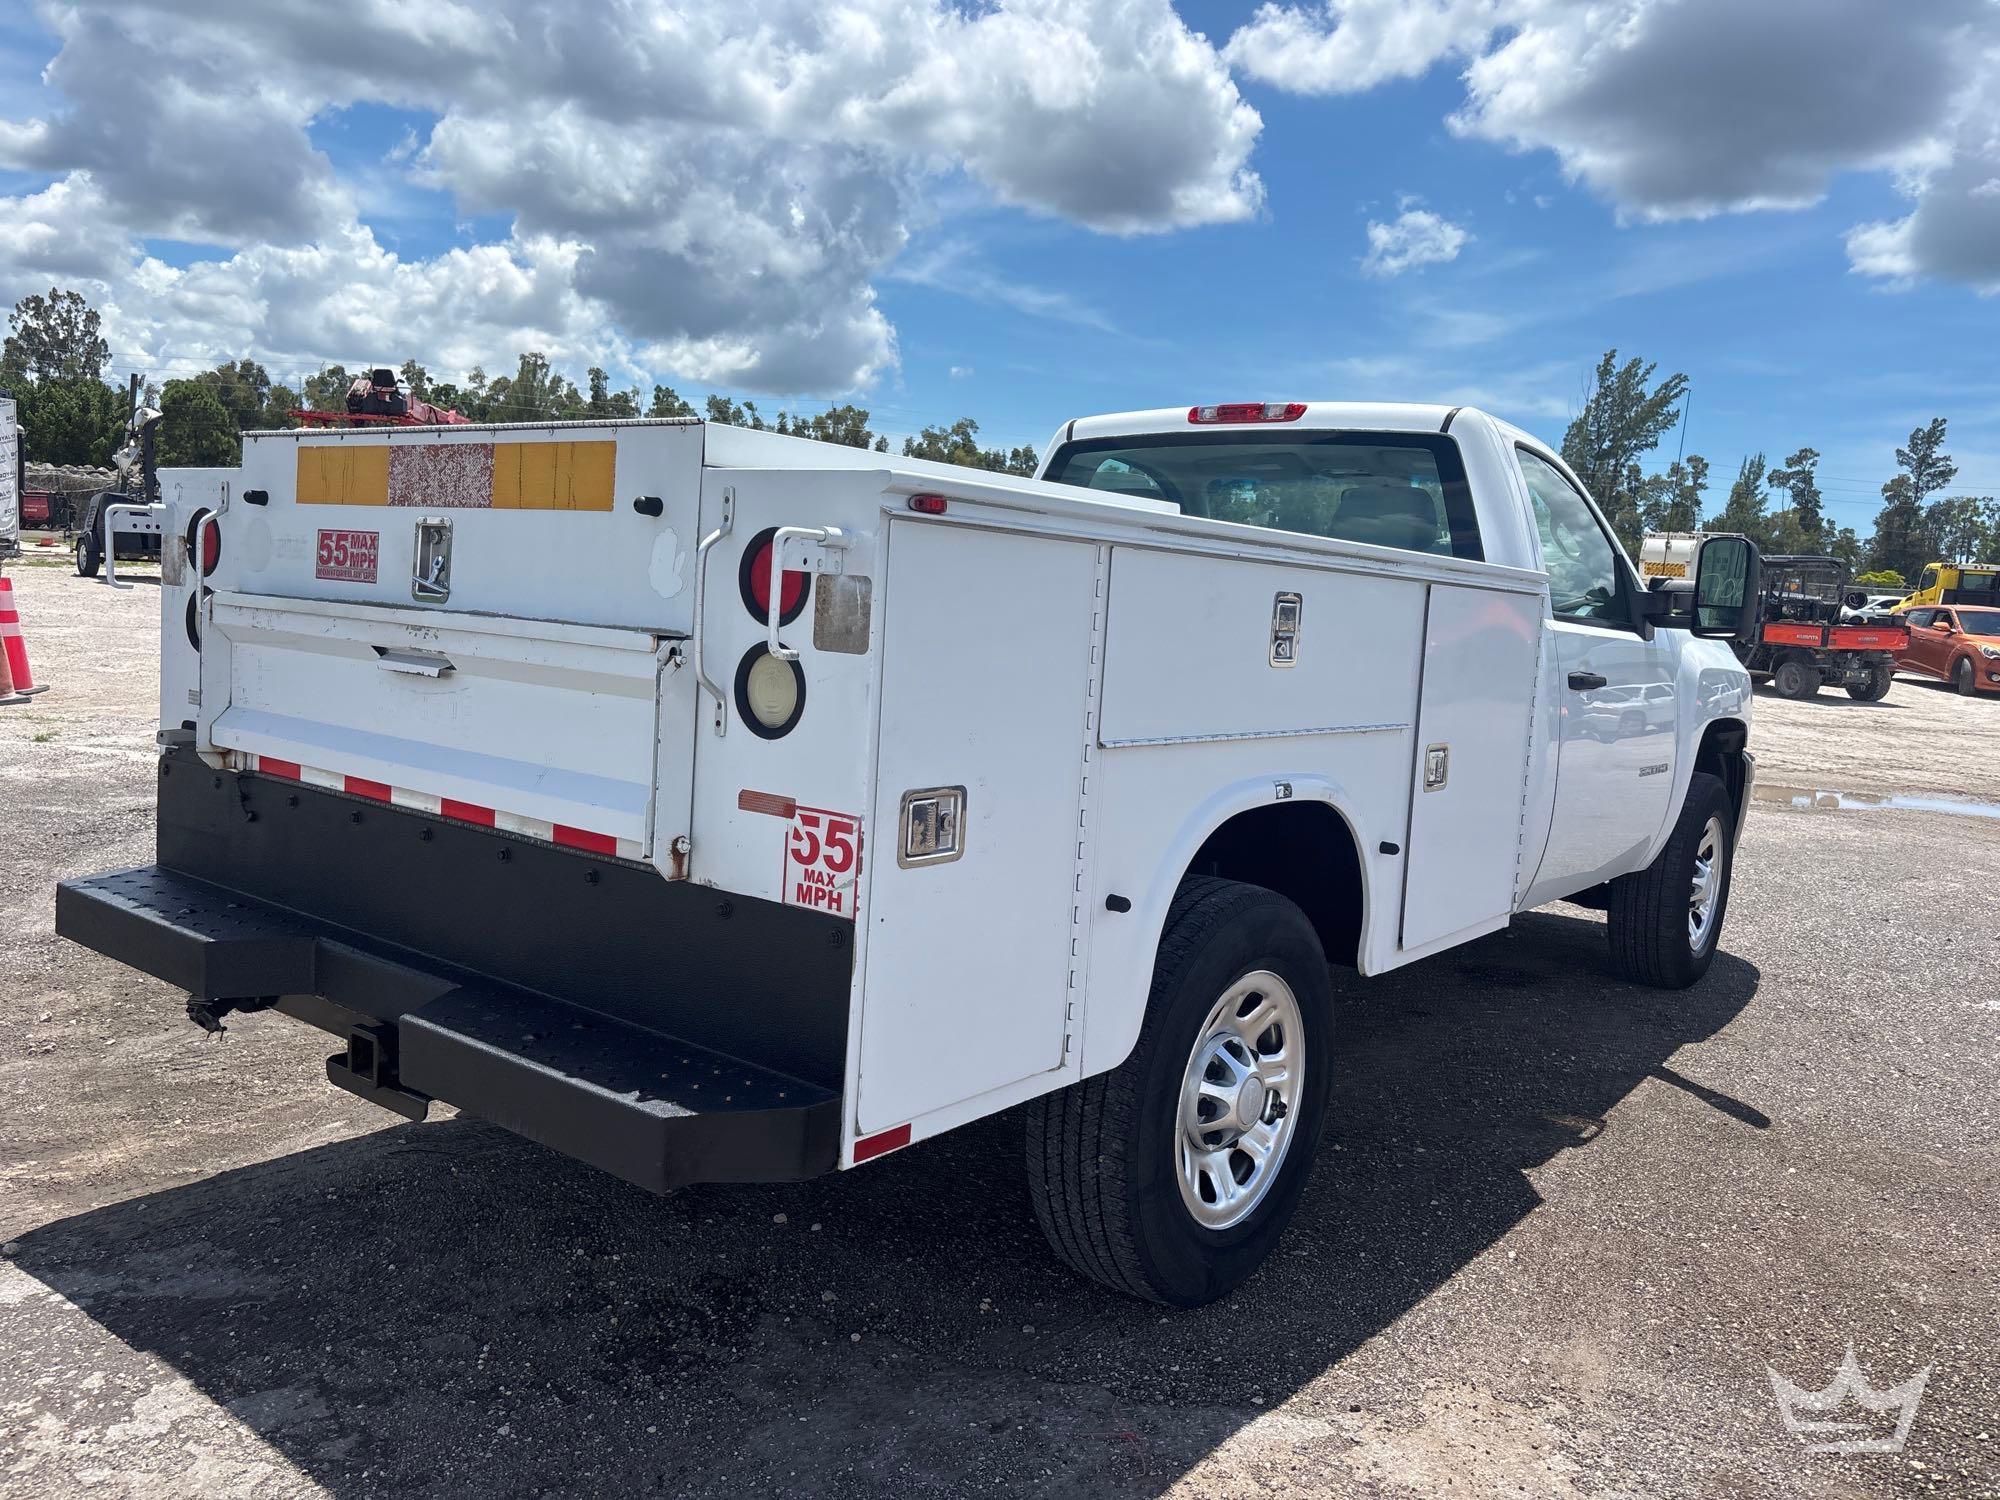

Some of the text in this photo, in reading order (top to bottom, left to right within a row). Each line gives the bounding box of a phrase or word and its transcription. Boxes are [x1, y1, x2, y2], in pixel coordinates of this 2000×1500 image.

[319, 532, 377, 567] 55 MAX
[349, 551, 377, 568] MPH
[791, 813, 854, 873] 55
[803, 868, 836, 888] MAX
[796, 883, 842, 912] MPH
